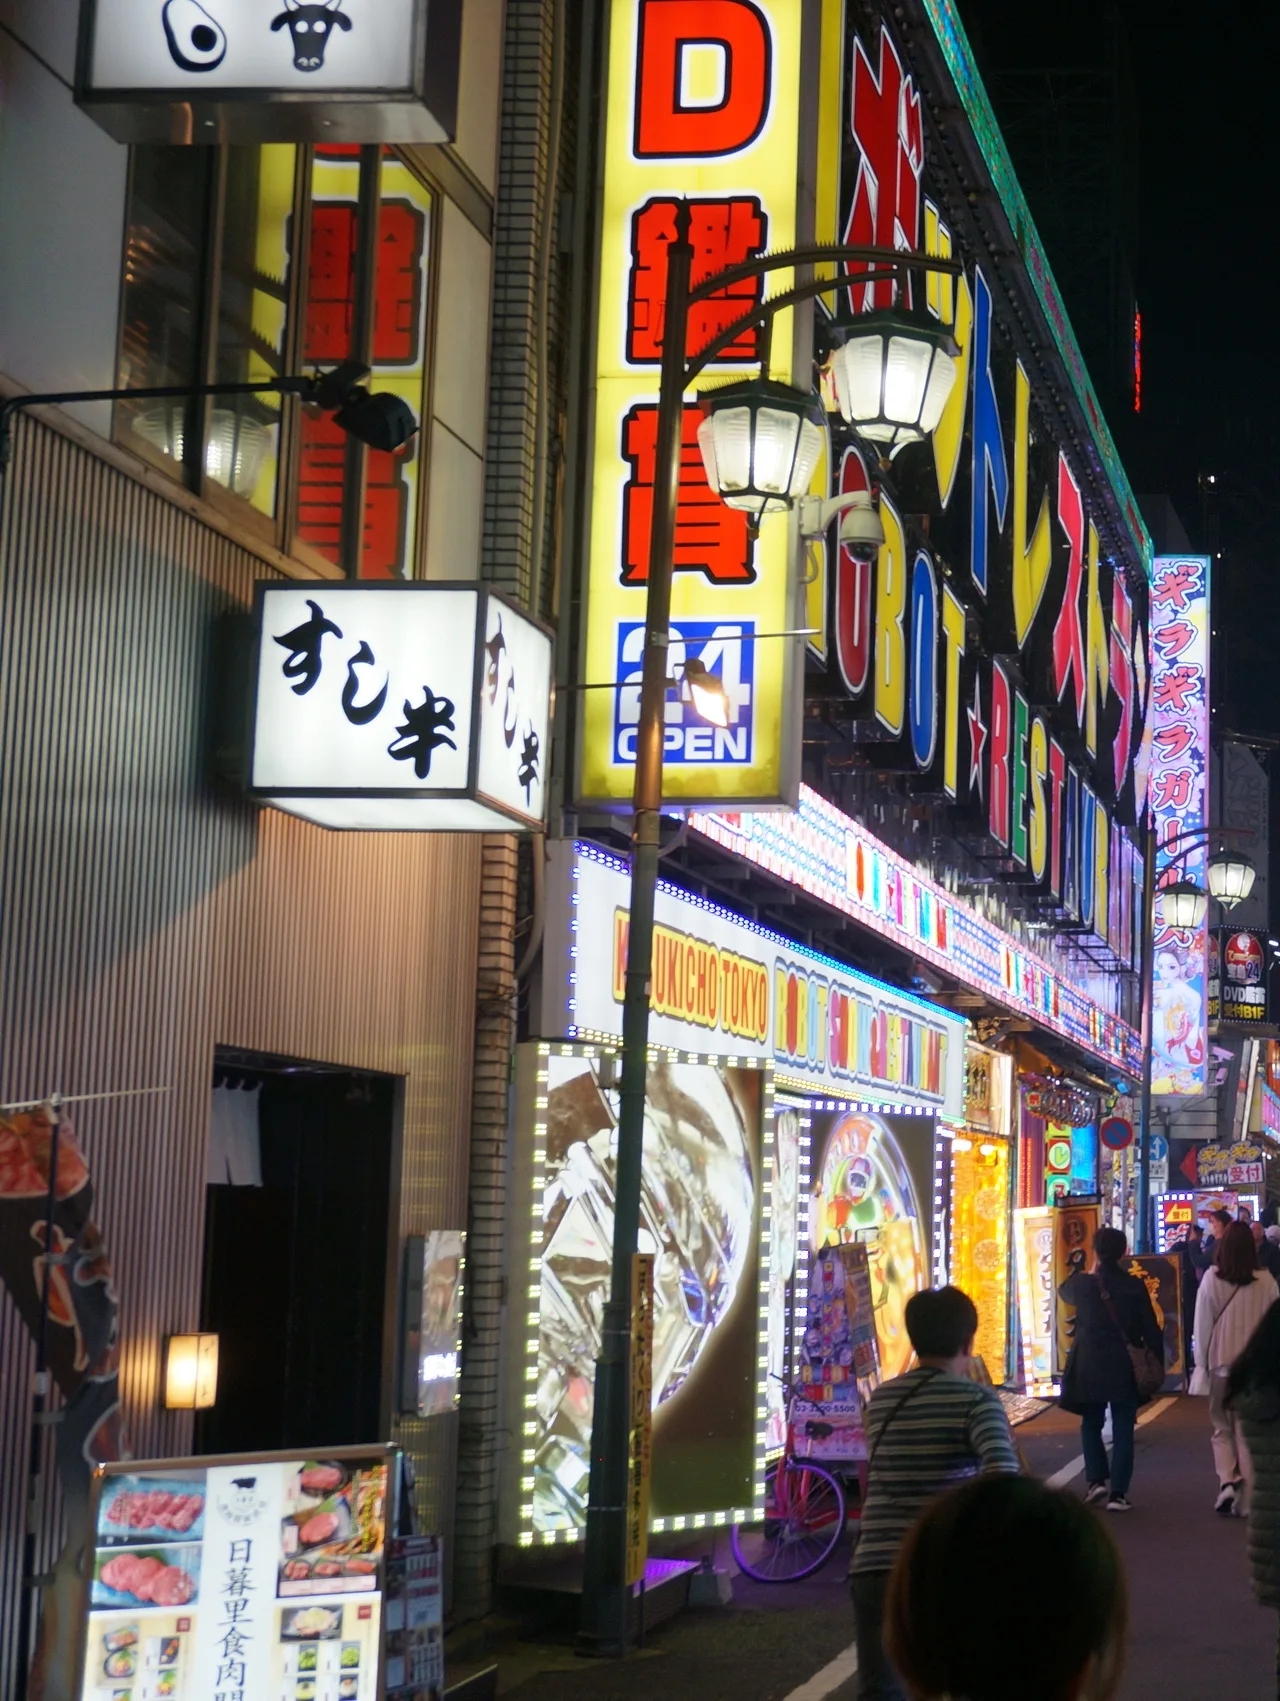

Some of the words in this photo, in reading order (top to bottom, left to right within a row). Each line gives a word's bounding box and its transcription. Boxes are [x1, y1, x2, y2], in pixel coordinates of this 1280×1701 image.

[617, 726, 747, 761] OPEN
[616, 917, 719, 1021] KUKICHO
[721, 959, 767, 1035] TOKYO
[775, 966, 828, 1063] ROBOT
[828, 989, 873, 1077] SHOW
[879, 1010, 948, 1096] RESTAURANT
[1230, 1164, 1261, 1183] 受付
